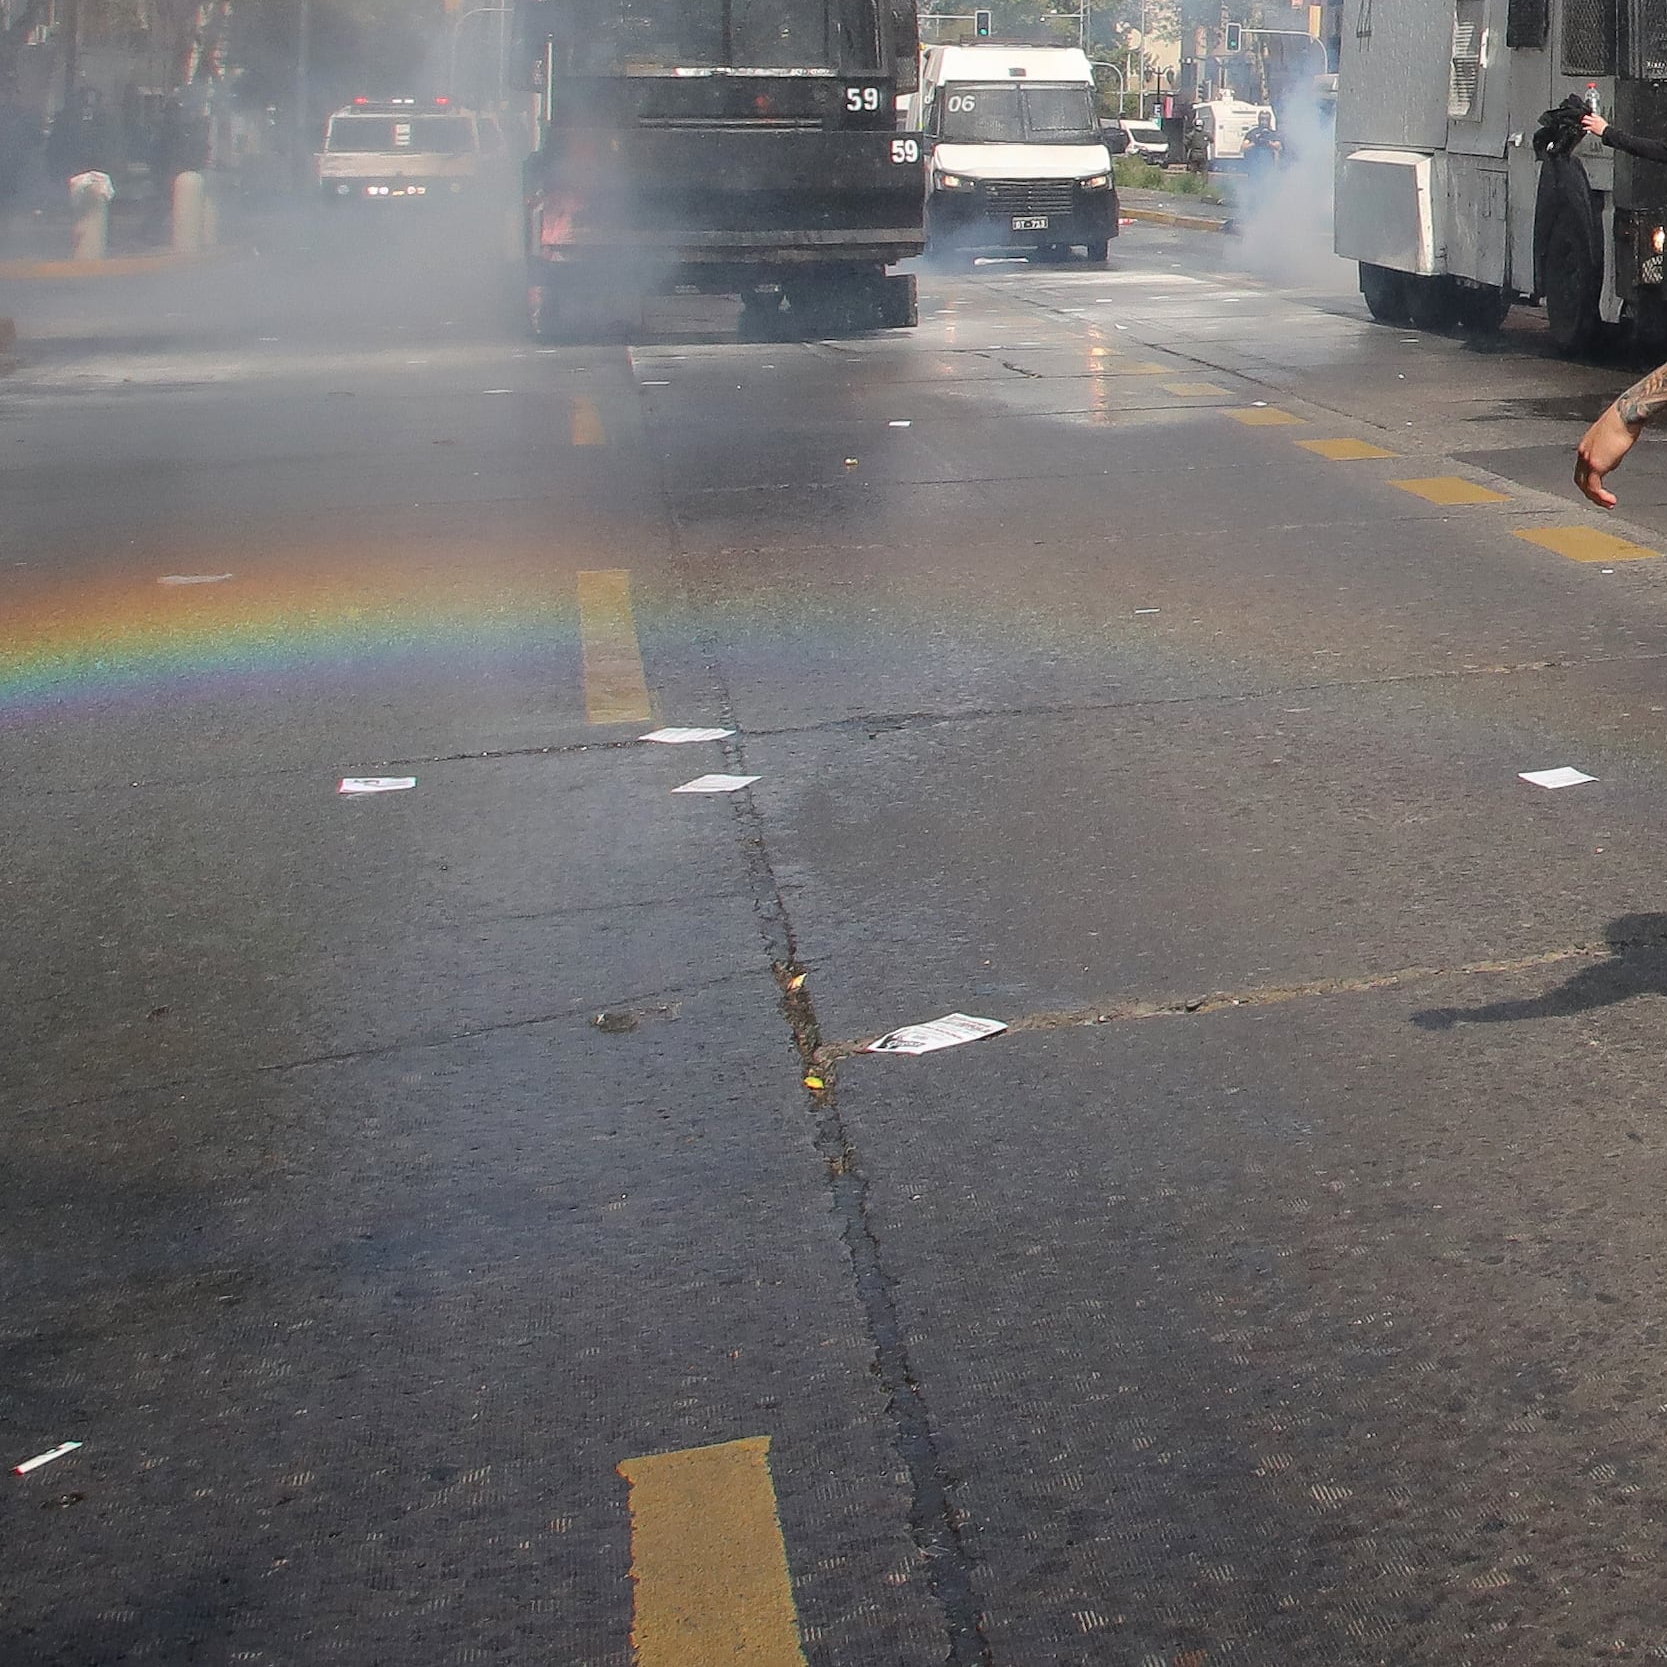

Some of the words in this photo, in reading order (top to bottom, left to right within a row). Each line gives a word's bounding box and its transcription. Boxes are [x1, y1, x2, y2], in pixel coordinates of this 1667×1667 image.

[846, 87, 879, 112] 59
[948, 94, 976, 112] 06
[891, 139, 919, 163] 59
